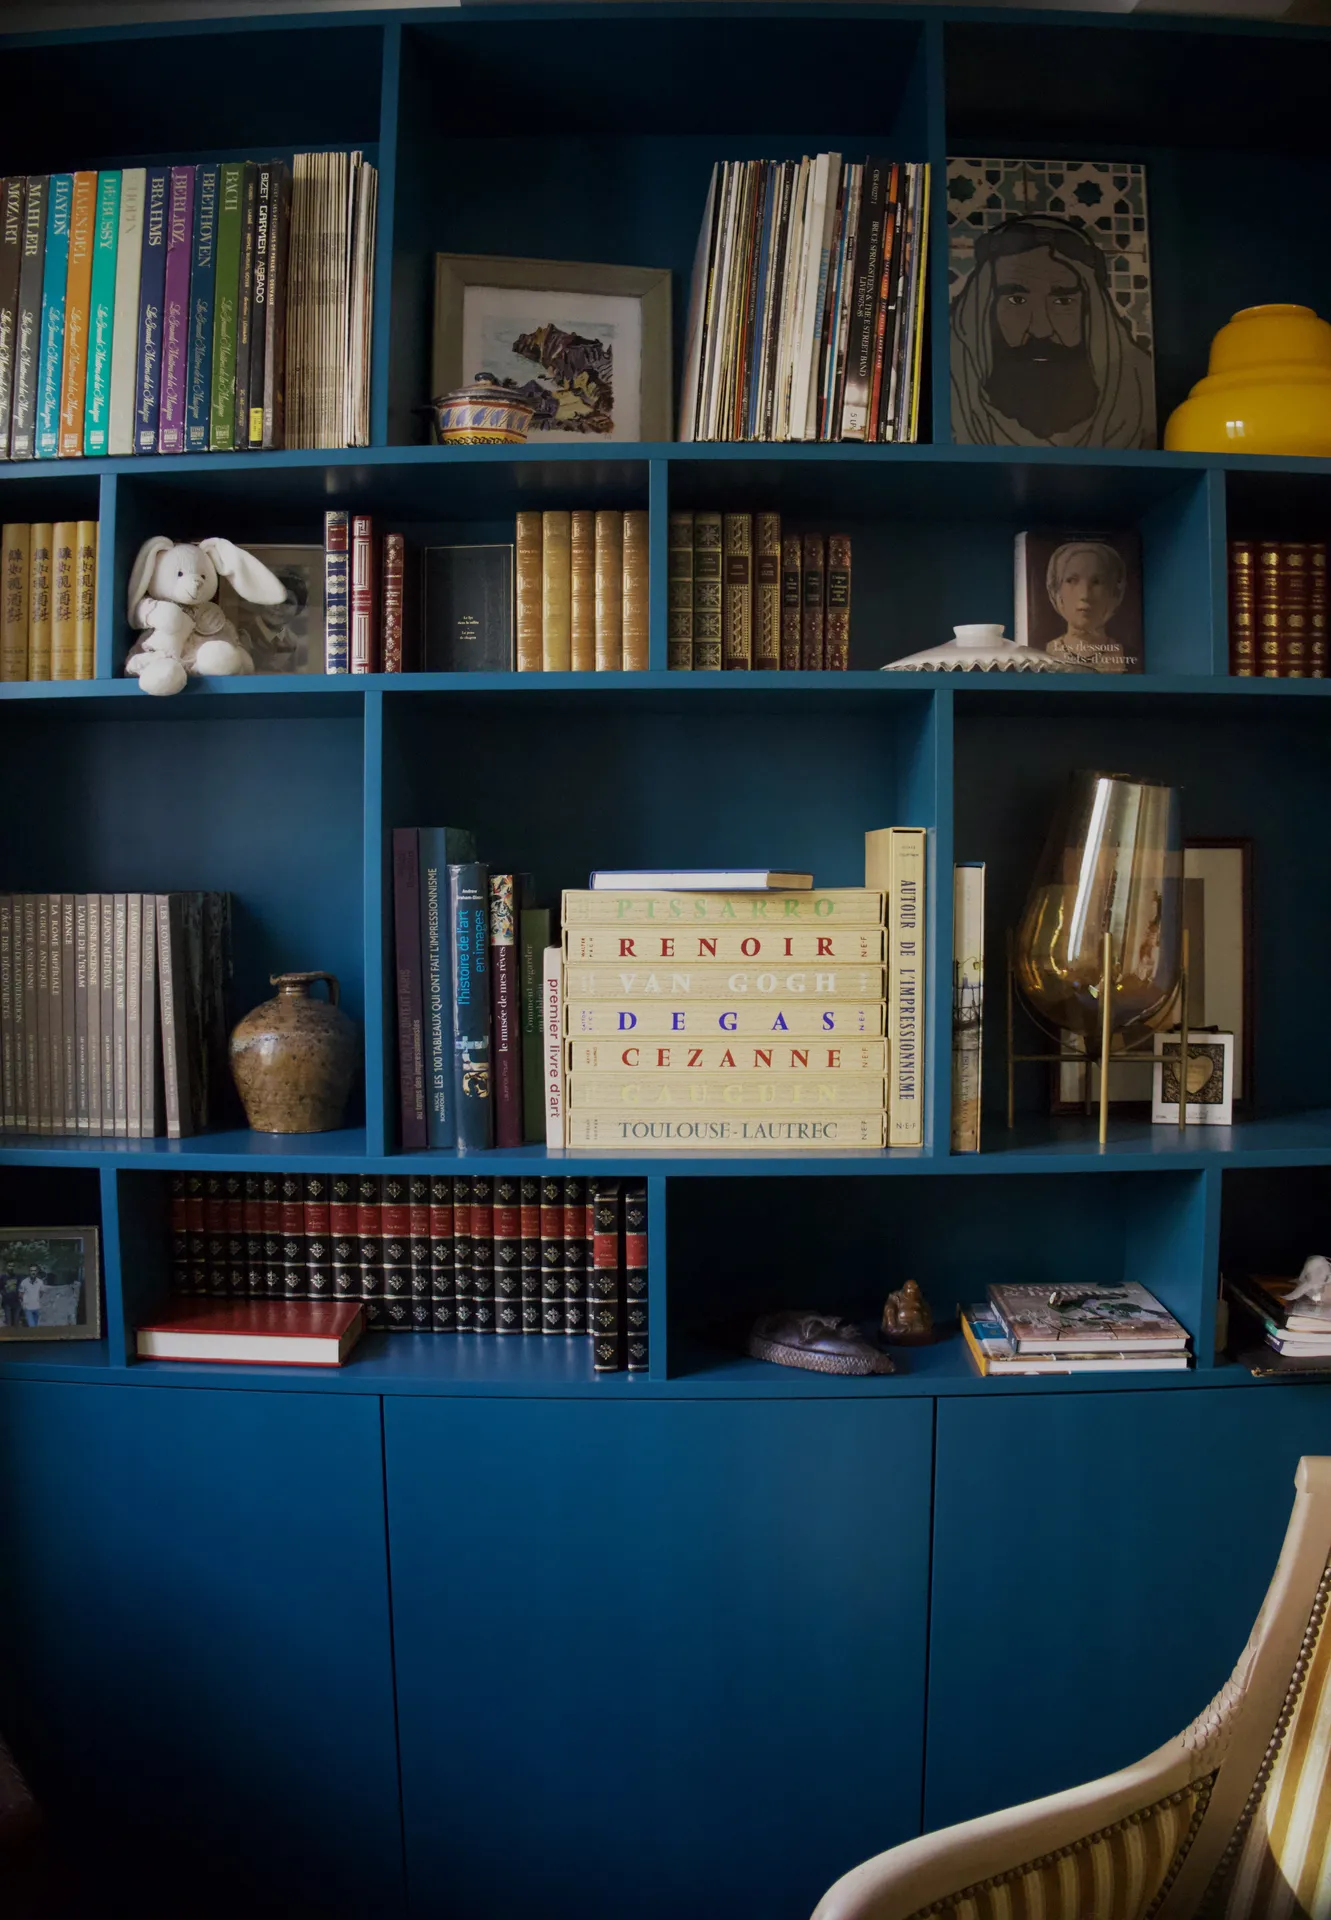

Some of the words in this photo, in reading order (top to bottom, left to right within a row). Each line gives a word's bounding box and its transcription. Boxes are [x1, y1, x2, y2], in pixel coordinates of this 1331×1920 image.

[225, 171, 238, 211] BACH
[260, 172, 270, 200] BIZET
[4, 182, 20, 244] MOZART
[24, 183, 42, 256] MAHLER
[54, 181, 69, 236] HAYDN
[100, 178, 116, 251] DEBUSSY
[149, 177, 165, 246] BRAHMS
[172, 173, 188, 242] BERLIOZ
[198, 172, 216, 268] BEETHOVEN
[74, 181, 90, 264] HAENDEL
[257, 205, 268, 255] CARMEN
[871, 220, 880, 243] BRUCE
[819, 248, 829, 278] ALAIN
[866, 243, 879, 292] SPRINGSTEEN
[255, 260, 266, 304] ABBADO
[864, 303, 872, 318] THE
[861, 325, 870, 355] STREET
[859, 355, 868, 377] BAND
[1054, 640, 1073, 652] Les
[1077, 639, 1120, 652] dessous
[2, 907, 10, 930] L'ÂGE
[40, 903, 46, 914] LA
[51, 904, 58, 915] LA
[90, 903, 97, 912] LA
[104, 904, 111, 914] LE
[428, 868, 440, 951] L'IMPRESSIONNISME
[617, 898, 834, 918] PISSARRO
[900, 880, 916, 929] AUTOUR
[104, 915, 112, 944] JAPON
[457, 910, 469, 933] l'art
[473, 910, 487, 954] images
[78, 938, 85, 950] DE
[144, 934, 152, 981] CLASSIQUE
[160, 924, 170, 974] ROYAUMES
[458, 936, 469, 950] de
[618, 938, 836, 957] RENOIR
[900, 941, 916, 957] DE
[52, 950, 60, 995] IMPÉRIALE
[78, 953, 86, 988] L'ISLAM
[90, 942, 98, 985] ANCIENNE
[104, 946, 112, 990] MÉDIÉVAL
[430, 952, 440, 971] FAIT
[476, 957, 484, 972] en
[496, 946, 506, 970] rêves
[524, 943, 536, 984] regarder
[2, 956, 10, 1020] DÉCOUVERTES
[117, 972, 124, 983] LA
[400, 968, 412, 994] PARIS
[430, 973, 440, 992] ONT
[458, 954, 470, 1004] l'histoire
[619, 973, 692, 993] VAN
[728, 973, 836, 993] GOGH
[162, 979, 172, 1025] AFRICAINS
[432, 994, 443, 1010] QUI
[498, 994, 508, 1007] de
[526, 988, 534, 1033] Comment
[548, 978, 559, 1039] premier
[432, 1012, 442, 1055] TABLEAUX
[498, 1009, 508, 1040] musée
[617, 1012, 836, 1031] DEGAS
[899, 969, 916, 1101] L'IMPRESSIONNISME
[413, 1019, 423, 1075] impressionnistes
[499, 1042, 508, 1052] le
[550, 1044, 560, 1078] livre
[622, 1048, 841, 1068] CEZANNE
[434, 1057, 443, 1072] 100
[414, 1076, 422, 1088] des
[434, 1074, 444, 1088] LES
[620, 1084, 837, 1104] GAUGUIN
[415, 1090, 424, 1110] temps
[550, 1083, 561, 1118] d'art
[417, 1111, 424, 1120] au
[618, 1122, 838, 1140] TOULOUSE-LAUTREC
